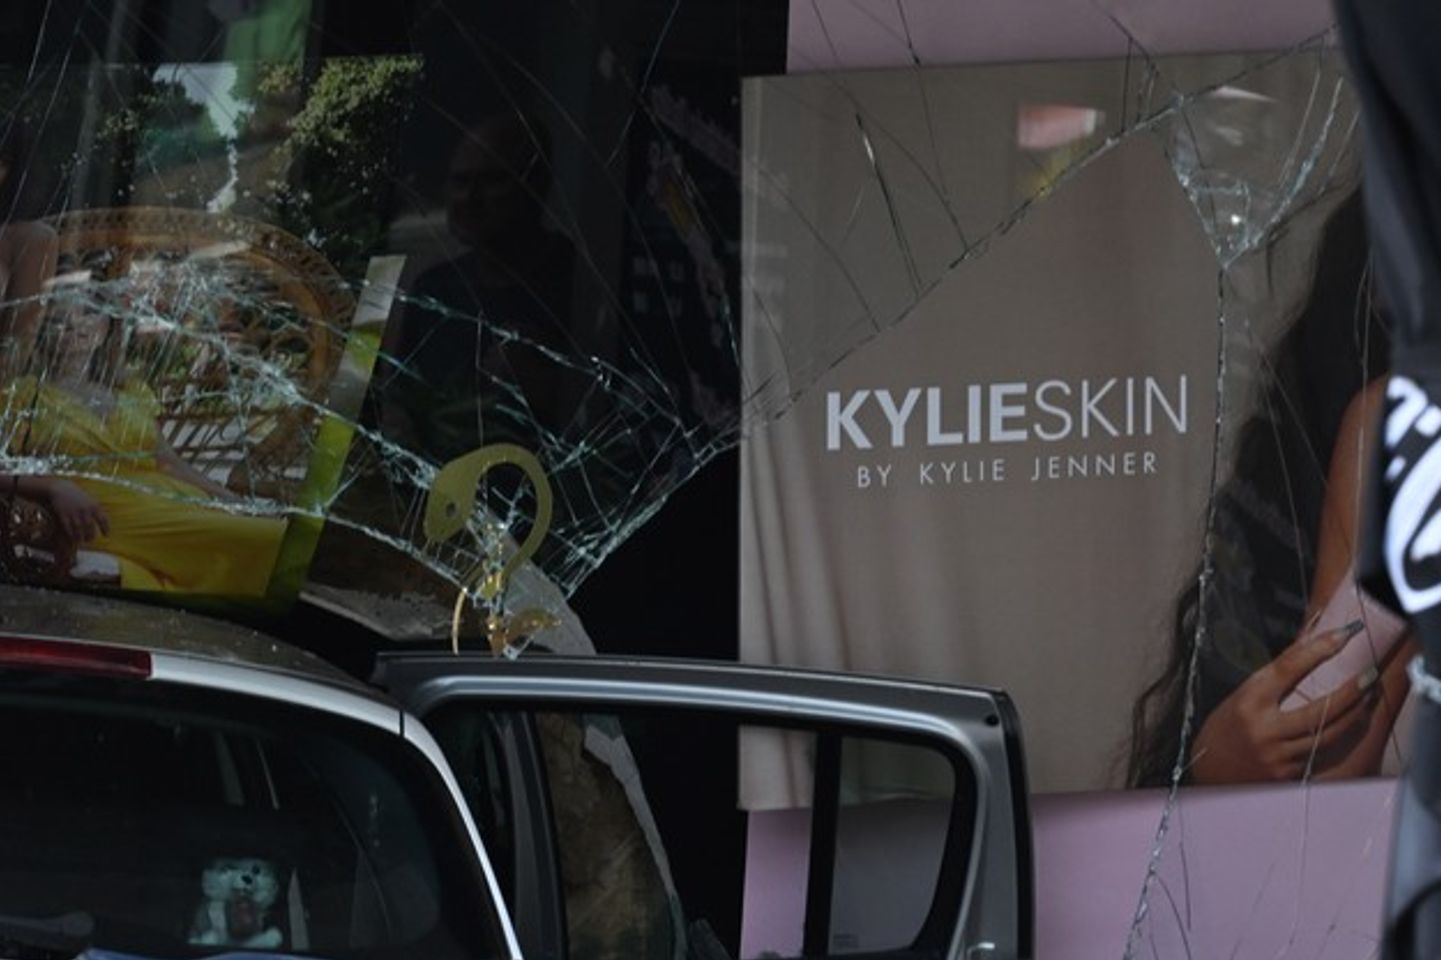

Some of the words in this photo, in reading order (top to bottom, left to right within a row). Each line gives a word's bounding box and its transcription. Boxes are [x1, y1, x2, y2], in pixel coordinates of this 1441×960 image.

[826, 374, 1188, 450] KYLIESKIN
[857, 464, 893, 488] BY
[919, 459, 1006, 484] KYLIE
[1031, 451, 1158, 481] JENNER
